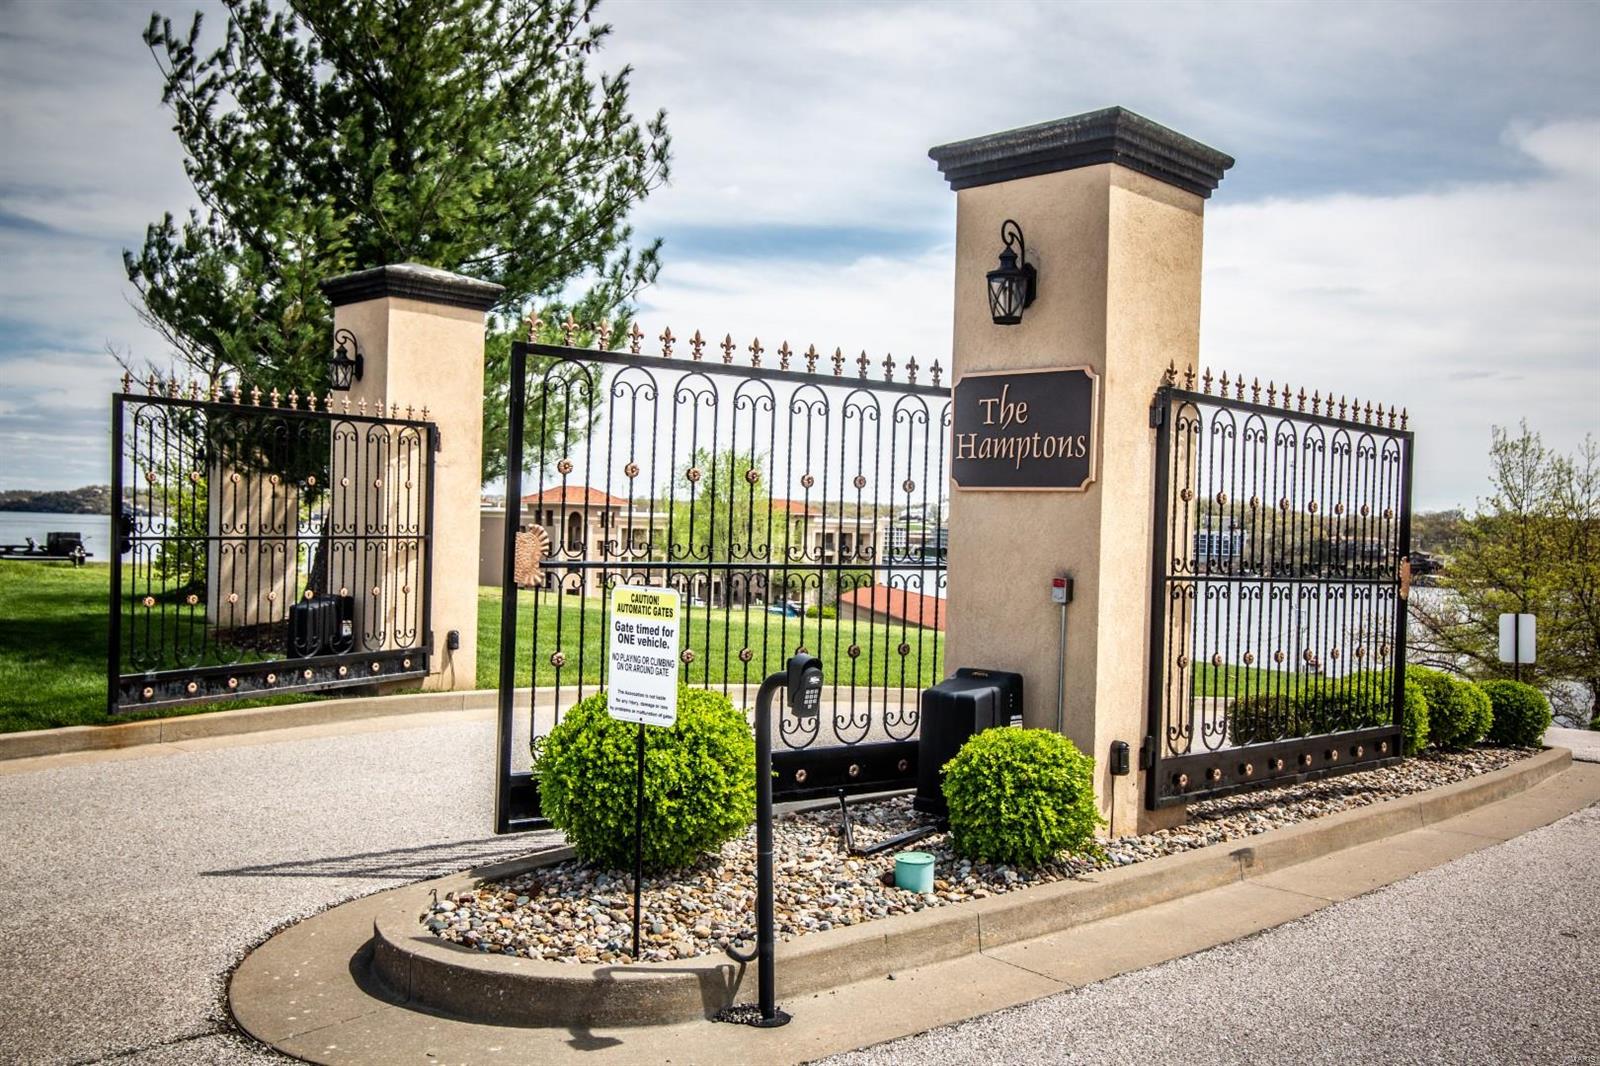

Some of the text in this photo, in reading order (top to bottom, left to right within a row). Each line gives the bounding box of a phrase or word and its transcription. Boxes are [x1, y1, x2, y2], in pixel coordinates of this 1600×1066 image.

[979, 384, 1028, 430] The
[955, 432, 1087, 470] Hamptons
[631, 593, 660, 605] CAUTION!
[617, 603, 674, 618] AUTOMATIC GATES
[615, 620, 674, 638] Gate timed for
[618, 633, 670, 649] ONE vehicle.
[612, 652, 675, 669] NO PLAYING OR CLIMBING
[617, 662, 669, 677] ON OR AROUND GATE
